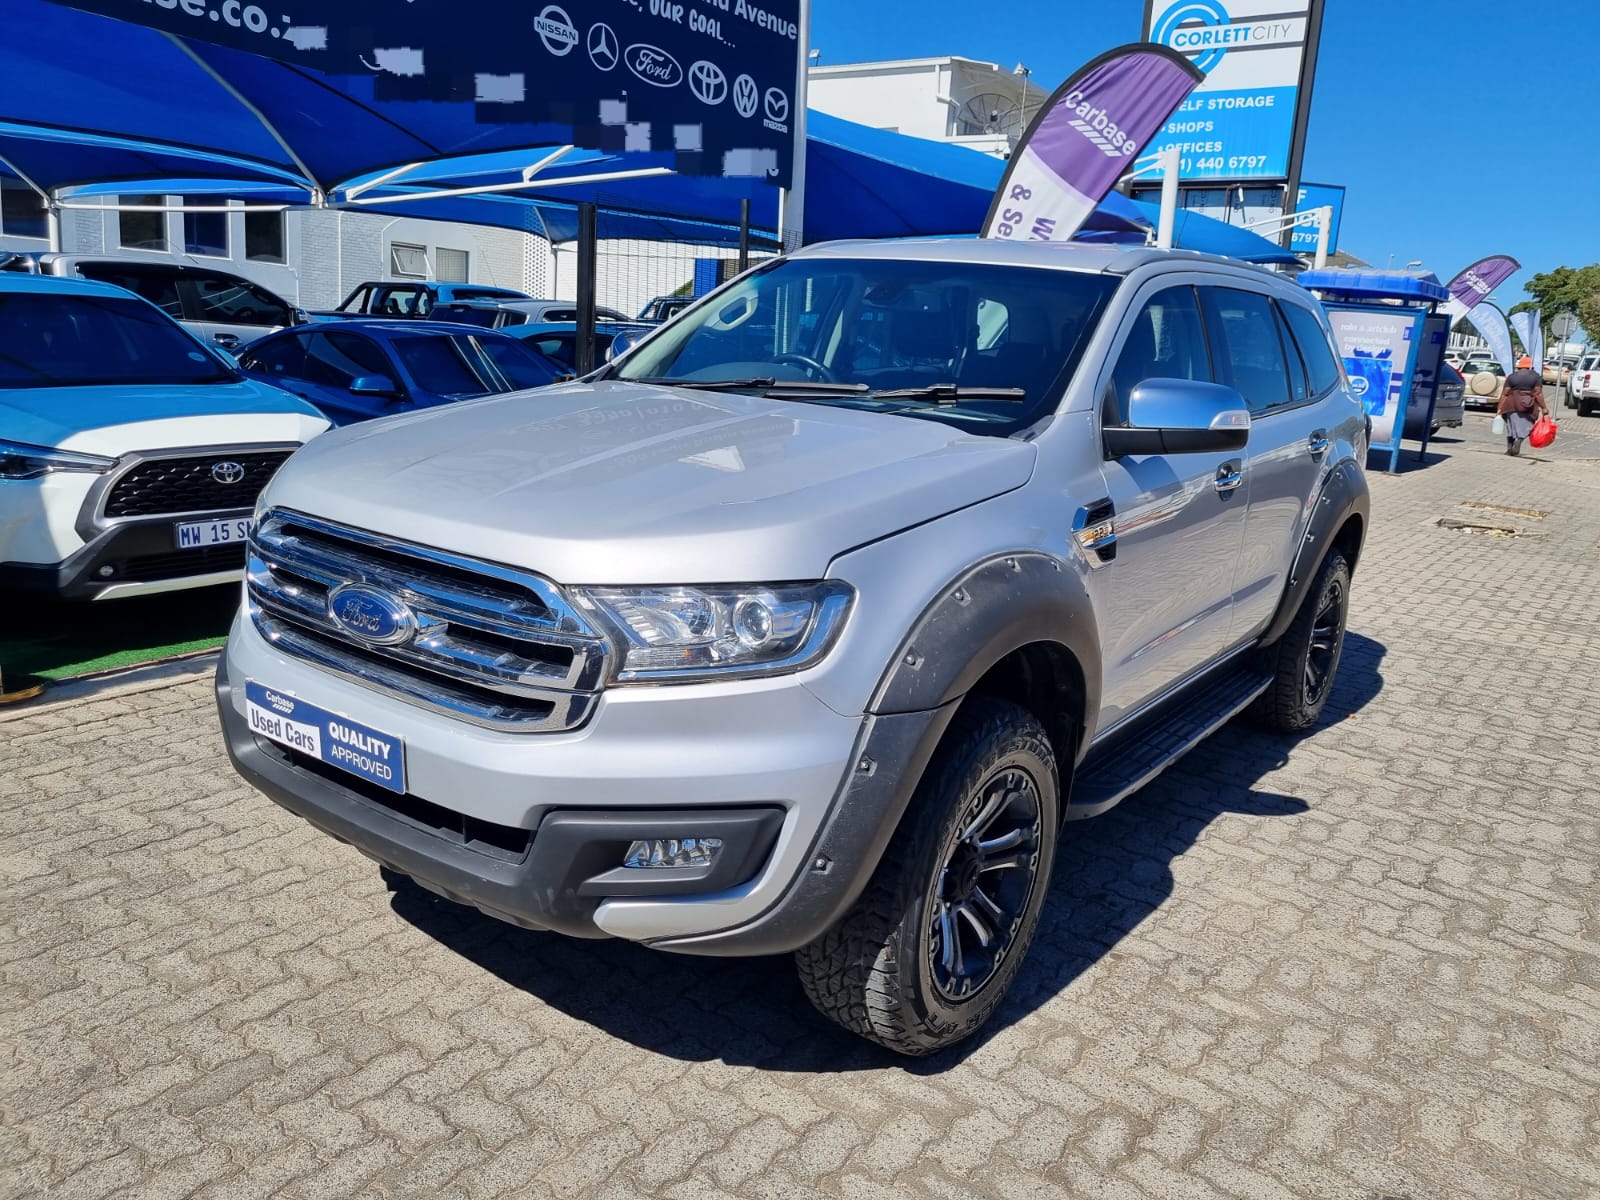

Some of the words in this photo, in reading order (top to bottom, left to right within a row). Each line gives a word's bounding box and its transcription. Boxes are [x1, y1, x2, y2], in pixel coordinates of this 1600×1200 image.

[536, 20, 577, 42] NISSAN
[734, 0, 798, 41] Avenue
[635, 49, 673, 81] Ford
[1178, 100, 1204, 113] ELF
[1207, 95, 1276, 111] STORAGE
[1065, 90, 1137, 156] Carbase
[1167, 121, 1214, 134] SHOPS
[1196, 156, 1224, 170] 440
[1228, 155, 1267, 169] 6797
[1009, 183, 1032, 201] &
[994, 208, 1023, 240] Se
[1028, 216, 1056, 240] W
[1291, 232, 1320, 243] 6797
[180, 526, 201, 546] MW
[210, 523, 230, 543] 15
[341, 598, 383, 632] Ford
[265, 690, 295, 710] Carbase
[251, 707, 282, 739] Used
[285, 721, 315, 752] Cars
[328, 721, 392, 760] QUALITY
[331, 744, 392, 781] APPROVED
